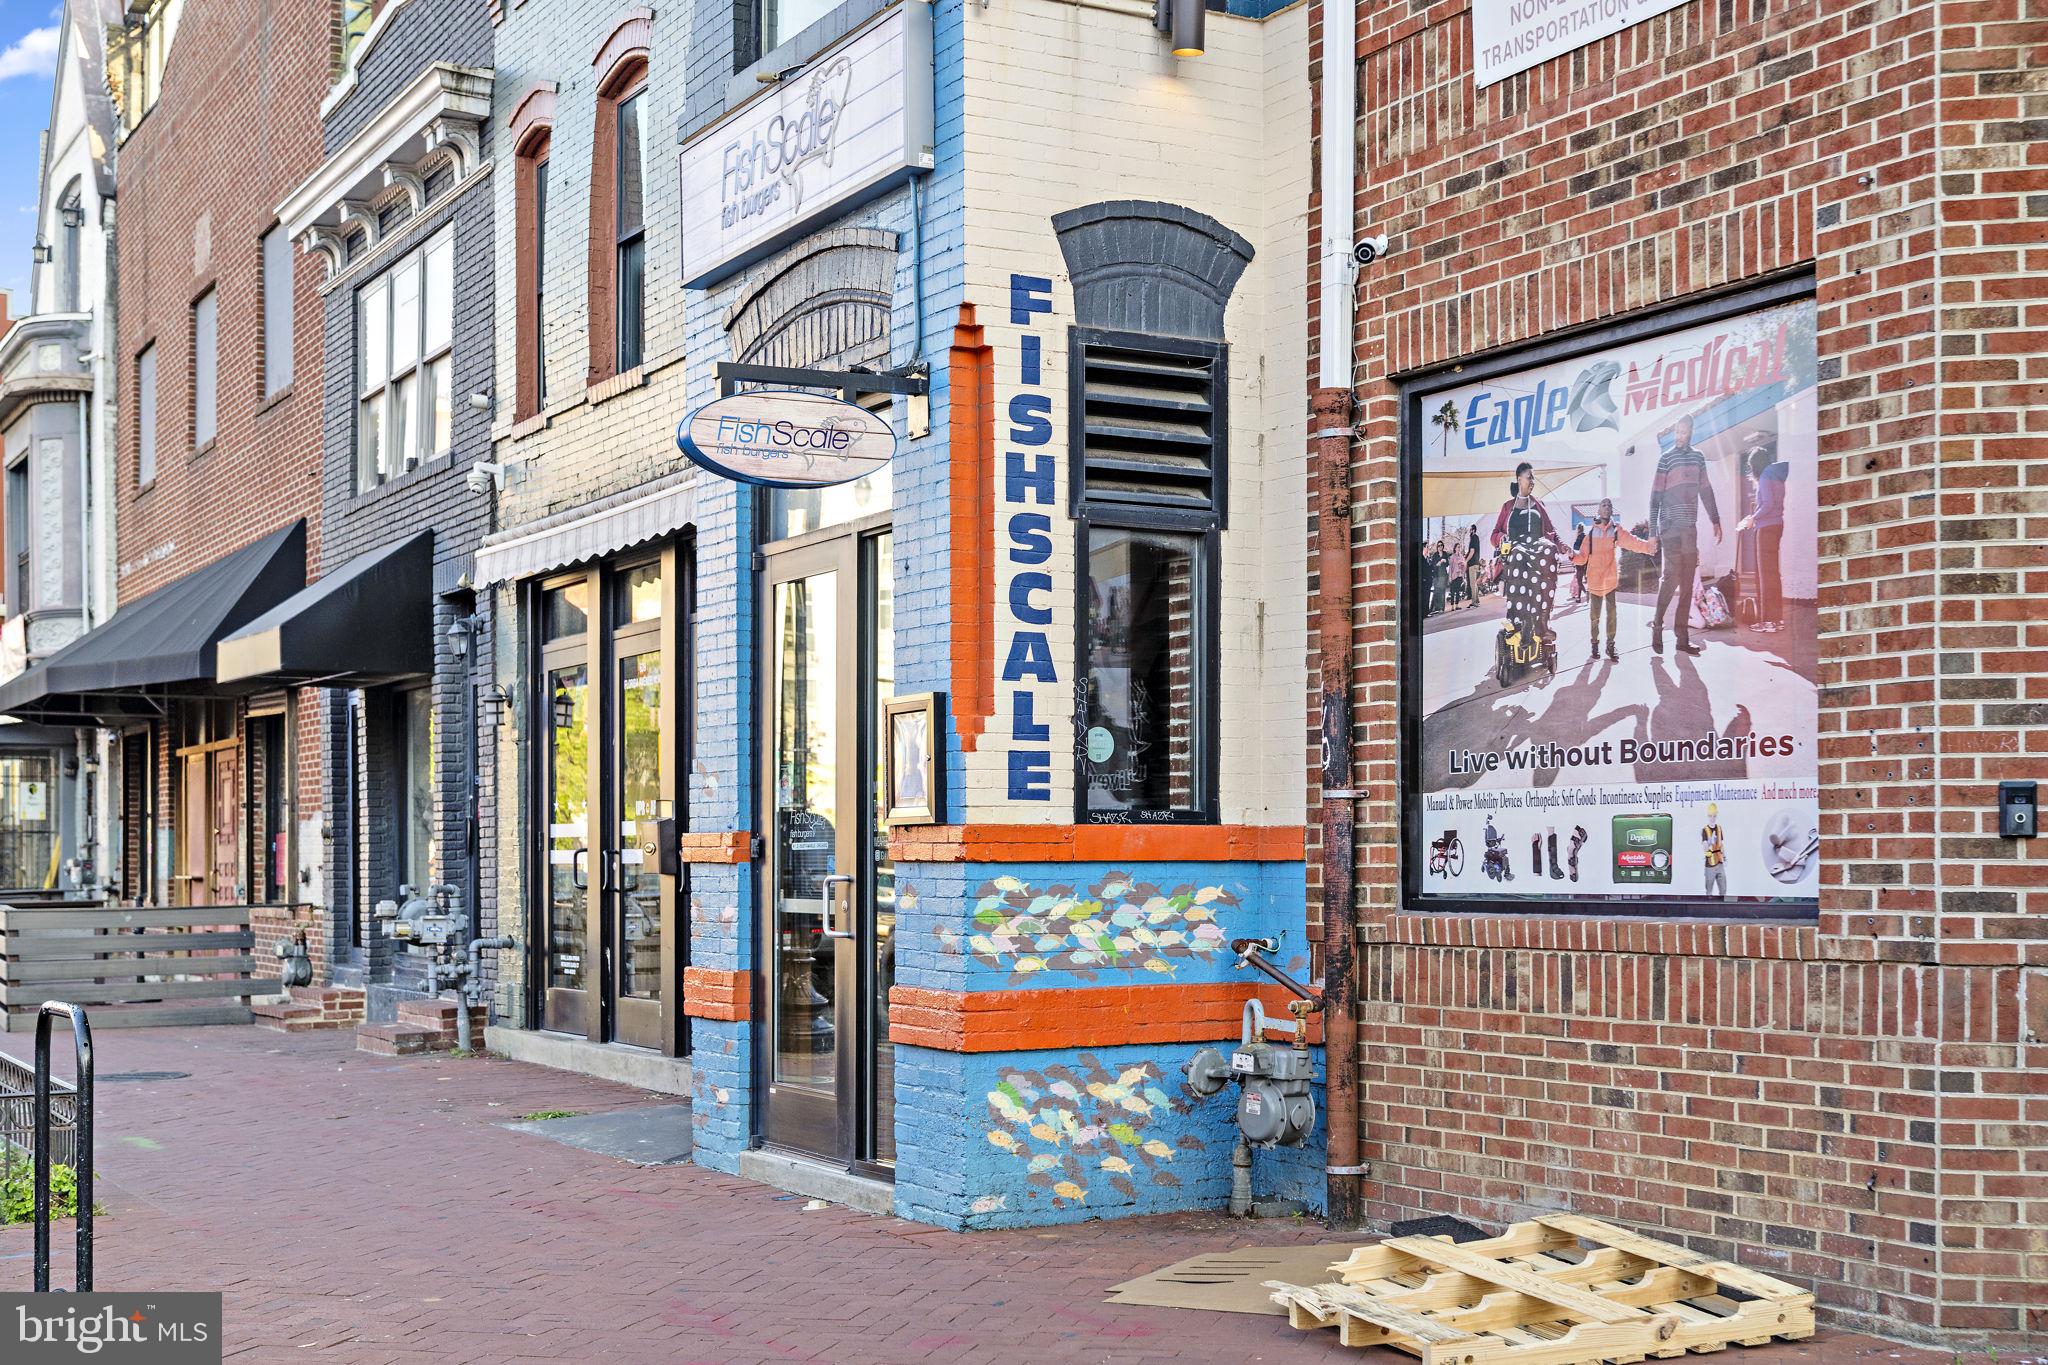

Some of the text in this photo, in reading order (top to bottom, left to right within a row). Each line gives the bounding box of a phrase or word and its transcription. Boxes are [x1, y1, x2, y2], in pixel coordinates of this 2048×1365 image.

[1482, 0, 1629, 69] TRANSPORTATION
[721, 92, 835, 202] FishScale
[721, 181, 781, 231] fish burgers
[1465, 322, 1791, 454] Eagle Medical
[716, 415, 850, 450] FishScale
[716, 442, 789, 459] fish burgers
[1002, 273, 1058, 801] FISHSCALE
[1450, 732, 1794, 773] Live without Boundaries
[1426, 795, 1447, 811] Manual
[1449, 795, 1455, 809] &
[1456, 794, 1472, 810] Power
[1474, 792, 1498, 814] Mobility
[1500, 791, 1523, 809] Devices
[1525, 789, 1560, 812] Orthopedic
[1561, 788, 1574, 806] Soft
[1576, 788, 1596, 806] Goods
[1600, 787, 1642, 805] Incontinence
[1644, 785, 1672, 810] Supplies
[1675, 784, 1712, 808] Equipment
[1714, 783, 1757, 801] Maintenance
[1762, 781, 1776, 800] And
[1778, 781, 1796, 799] much
